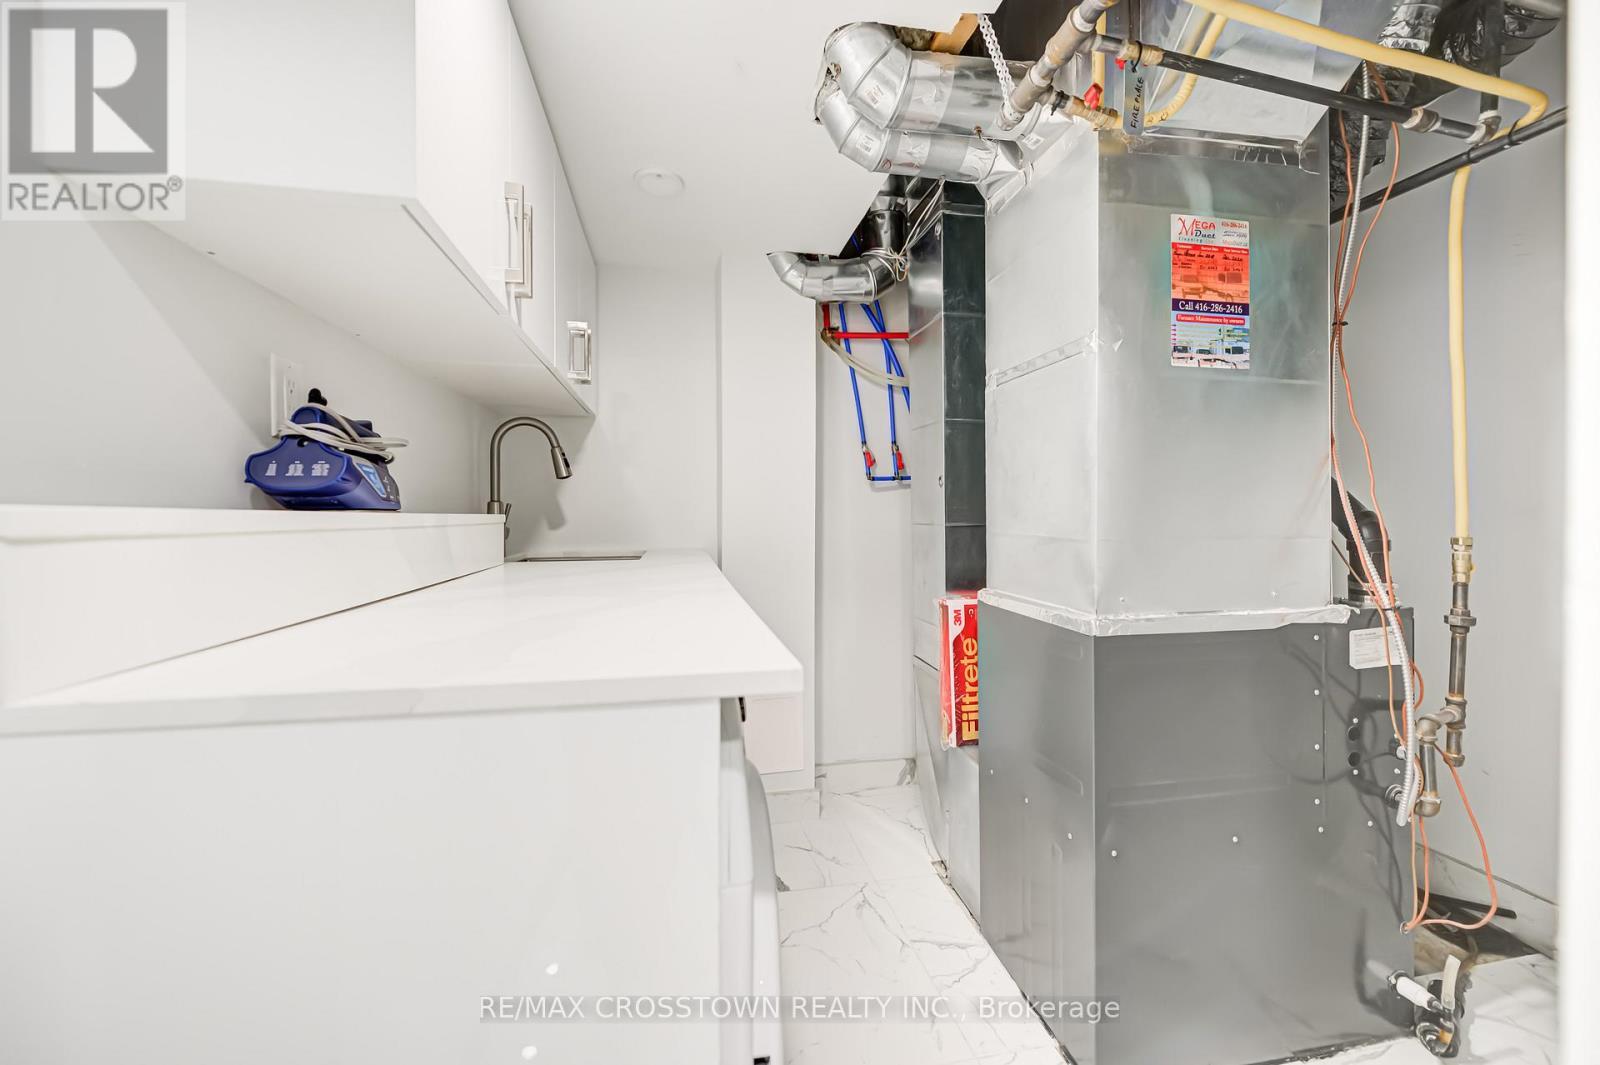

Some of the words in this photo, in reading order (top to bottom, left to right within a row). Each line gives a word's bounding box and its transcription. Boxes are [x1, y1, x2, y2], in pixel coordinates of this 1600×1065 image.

[1177, 217, 1216, 236] MEGA
[1194, 229, 1216, 239] Duct
[1178, 300, 1194, 311] Call
[1194, 302, 1243, 313] 416-286-2416
[953, 609, 962, 626] 3M
[960, 637, 978, 741] Filtrete
